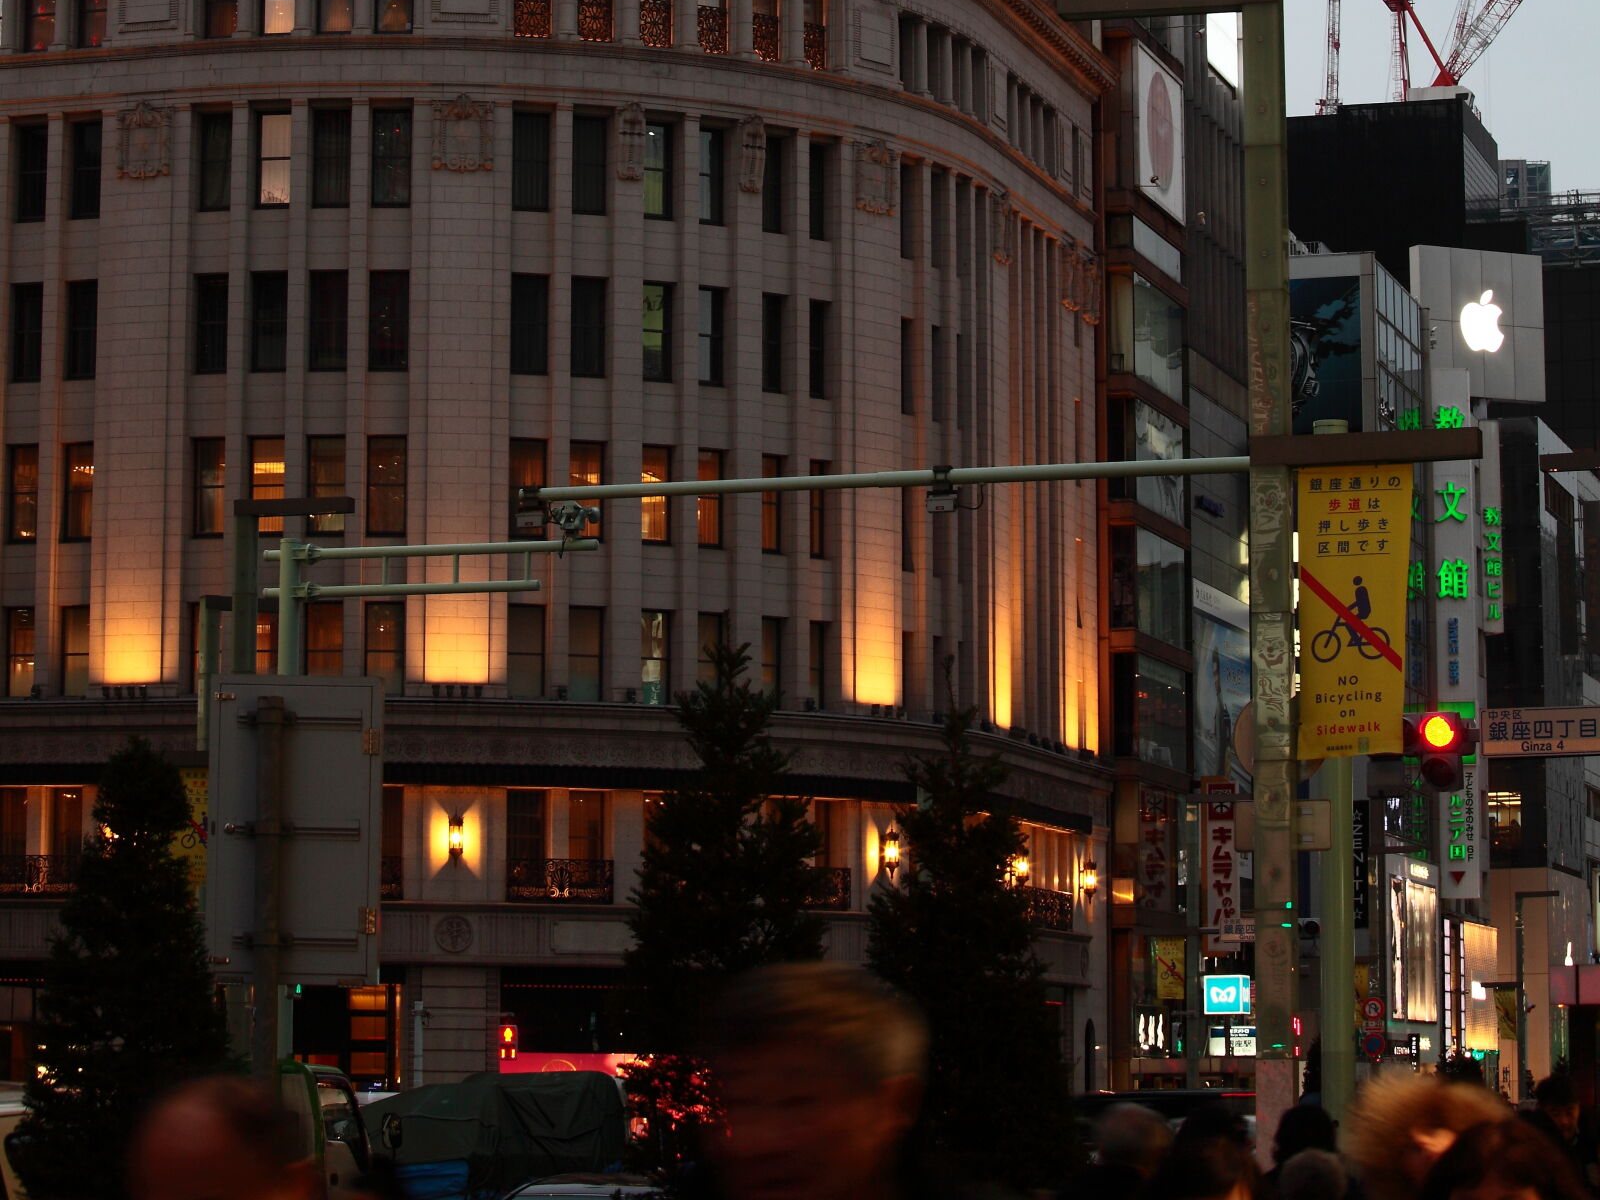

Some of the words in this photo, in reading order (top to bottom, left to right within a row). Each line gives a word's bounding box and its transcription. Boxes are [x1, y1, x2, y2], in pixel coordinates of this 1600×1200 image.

[1310, 476, 1401, 491] 銀座通りの
[1328, 497, 1380, 511] 歩道は
[1318, 518, 1389, 533] 押し歩き
[1318, 539, 1389, 554] 区間です
[1483, 506, 1502, 620] 教文館ビル
[1338, 675, 1359, 686] NO
[1315, 691, 1382, 705] Bicycling
[1340, 708, 1355, 718] on
[1488, 709, 1522, 720] 中央区
[1316, 721, 1381, 736] Sidewalk
[1489, 719, 1596, 741] 銀座四丁目
[1521, 741, 1552, 752] Ginza
[1557, 741, 1564, 750] 4
[1465, 772, 1473, 841] 子どもの本のみせ
[1212, 826, 1235, 942] キムラヤのパ
